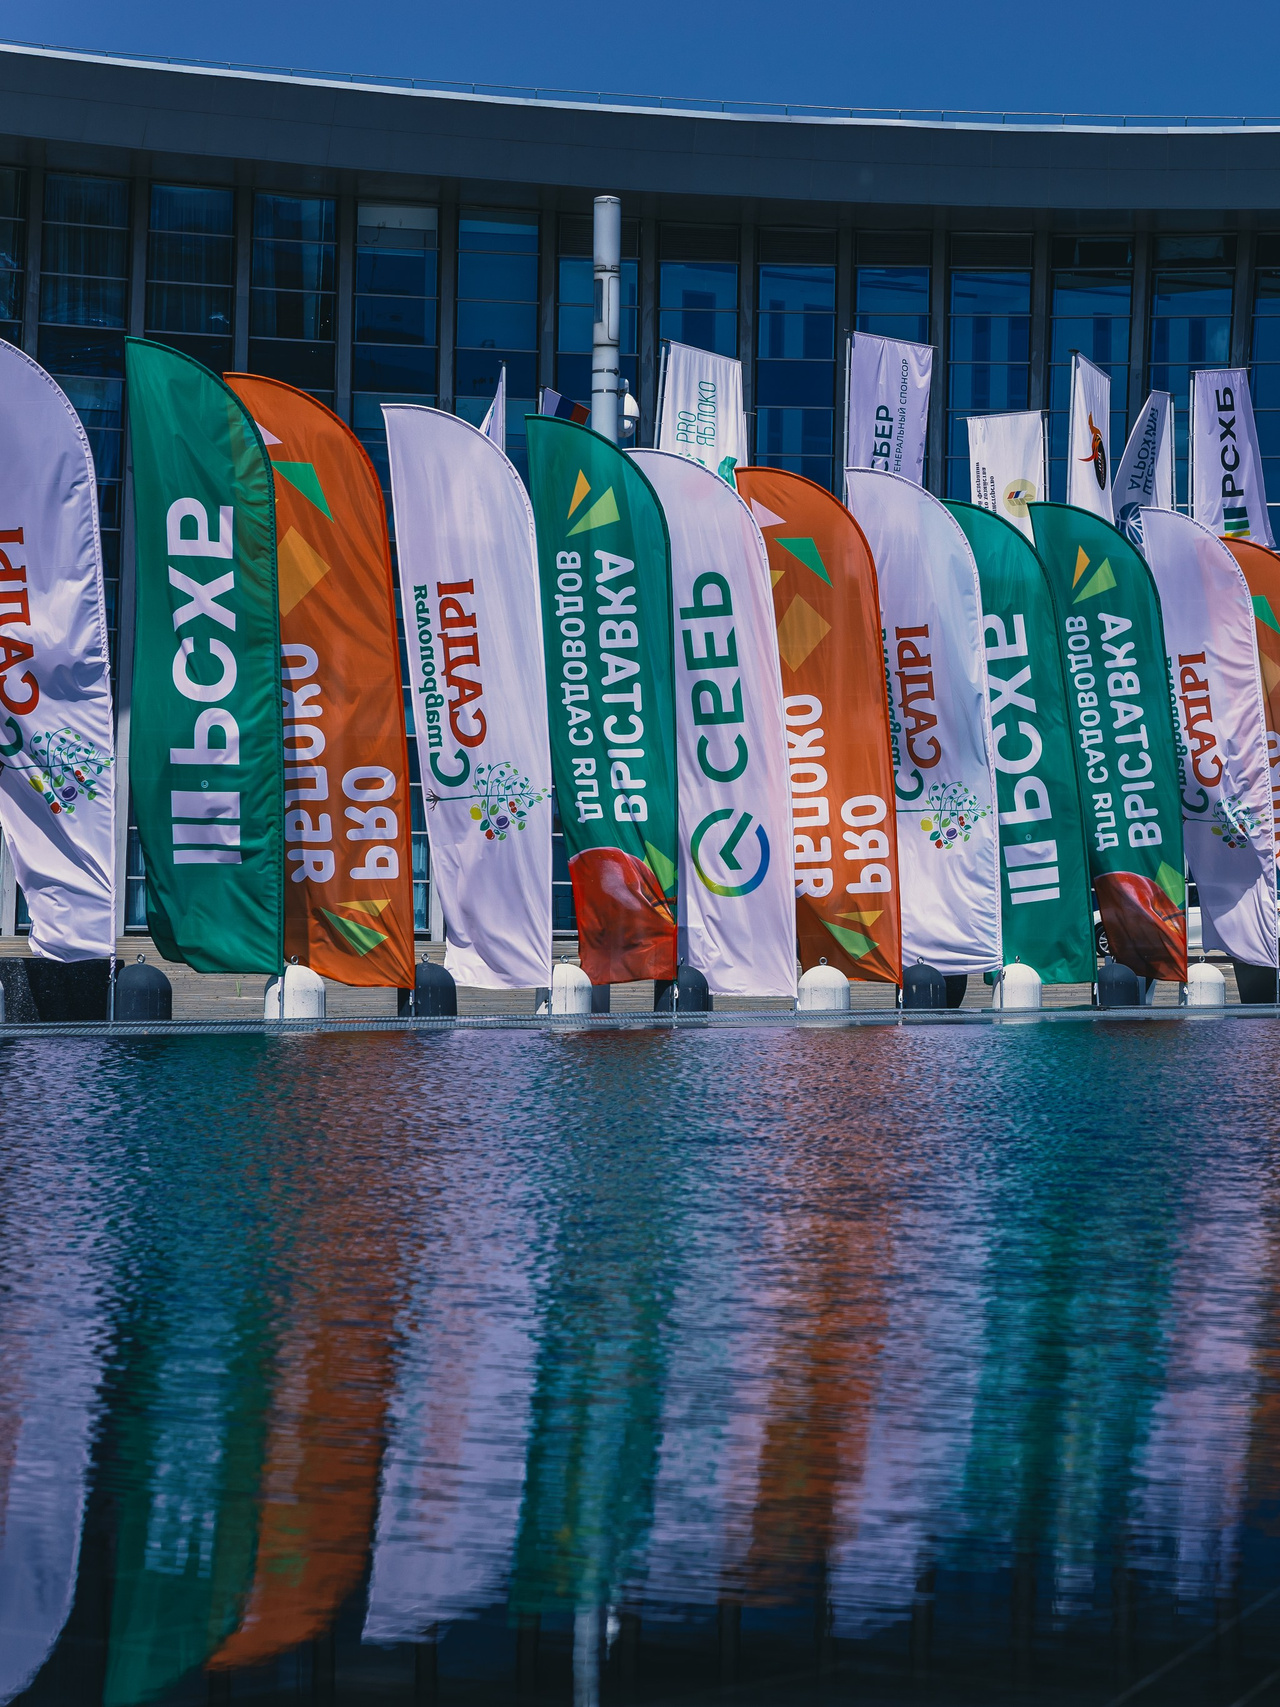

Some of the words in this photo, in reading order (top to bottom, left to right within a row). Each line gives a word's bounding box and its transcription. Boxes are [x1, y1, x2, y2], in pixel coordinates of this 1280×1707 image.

[899, 358, 909, 405] СПОНСОР
[675, 410, 697, 444] PRO
[696, 380, 717, 447] ЯБЛОКО
[1214, 386, 1244, 498] РСХБ
